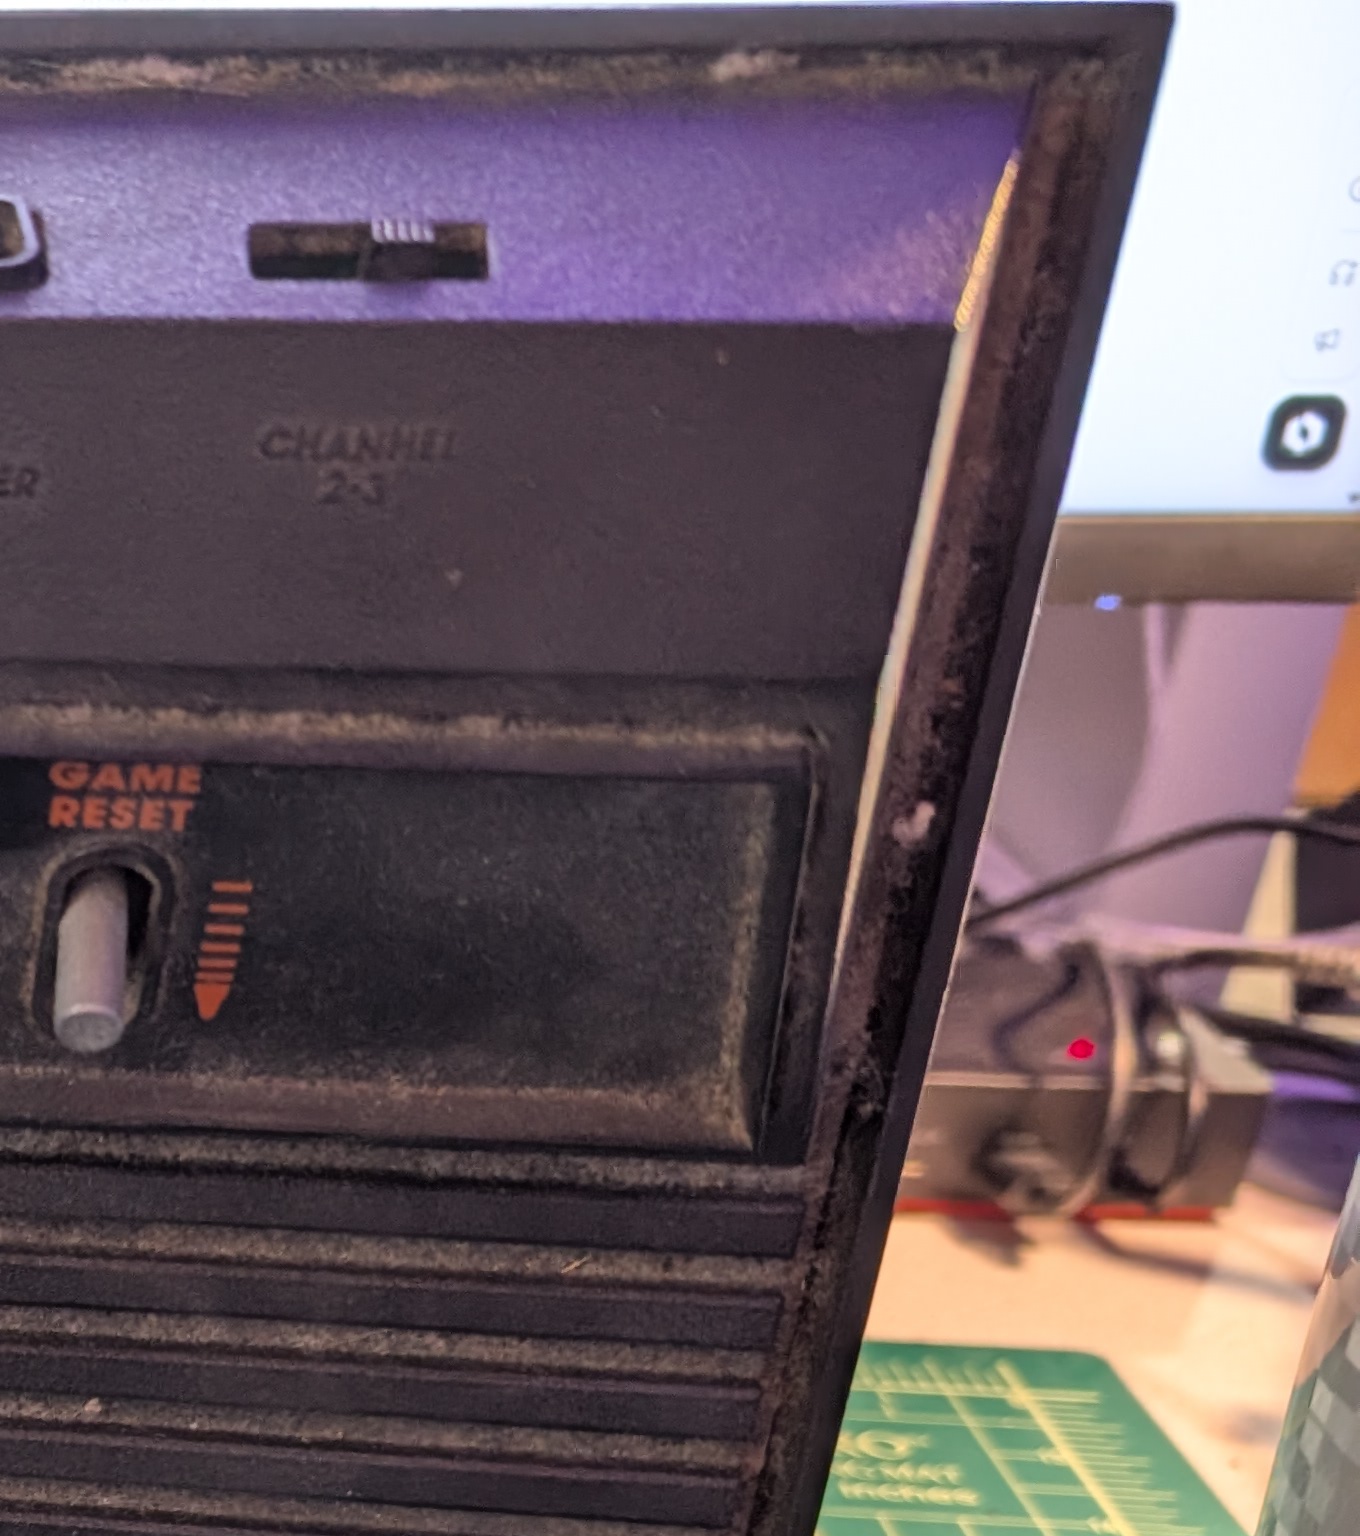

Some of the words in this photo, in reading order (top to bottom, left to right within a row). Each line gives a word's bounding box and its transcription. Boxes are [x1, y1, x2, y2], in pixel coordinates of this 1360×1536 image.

[259, 424, 456, 462] CHANNEL
[47, 760, 203, 795] GAME
[47, 796, 196, 832] RESET
